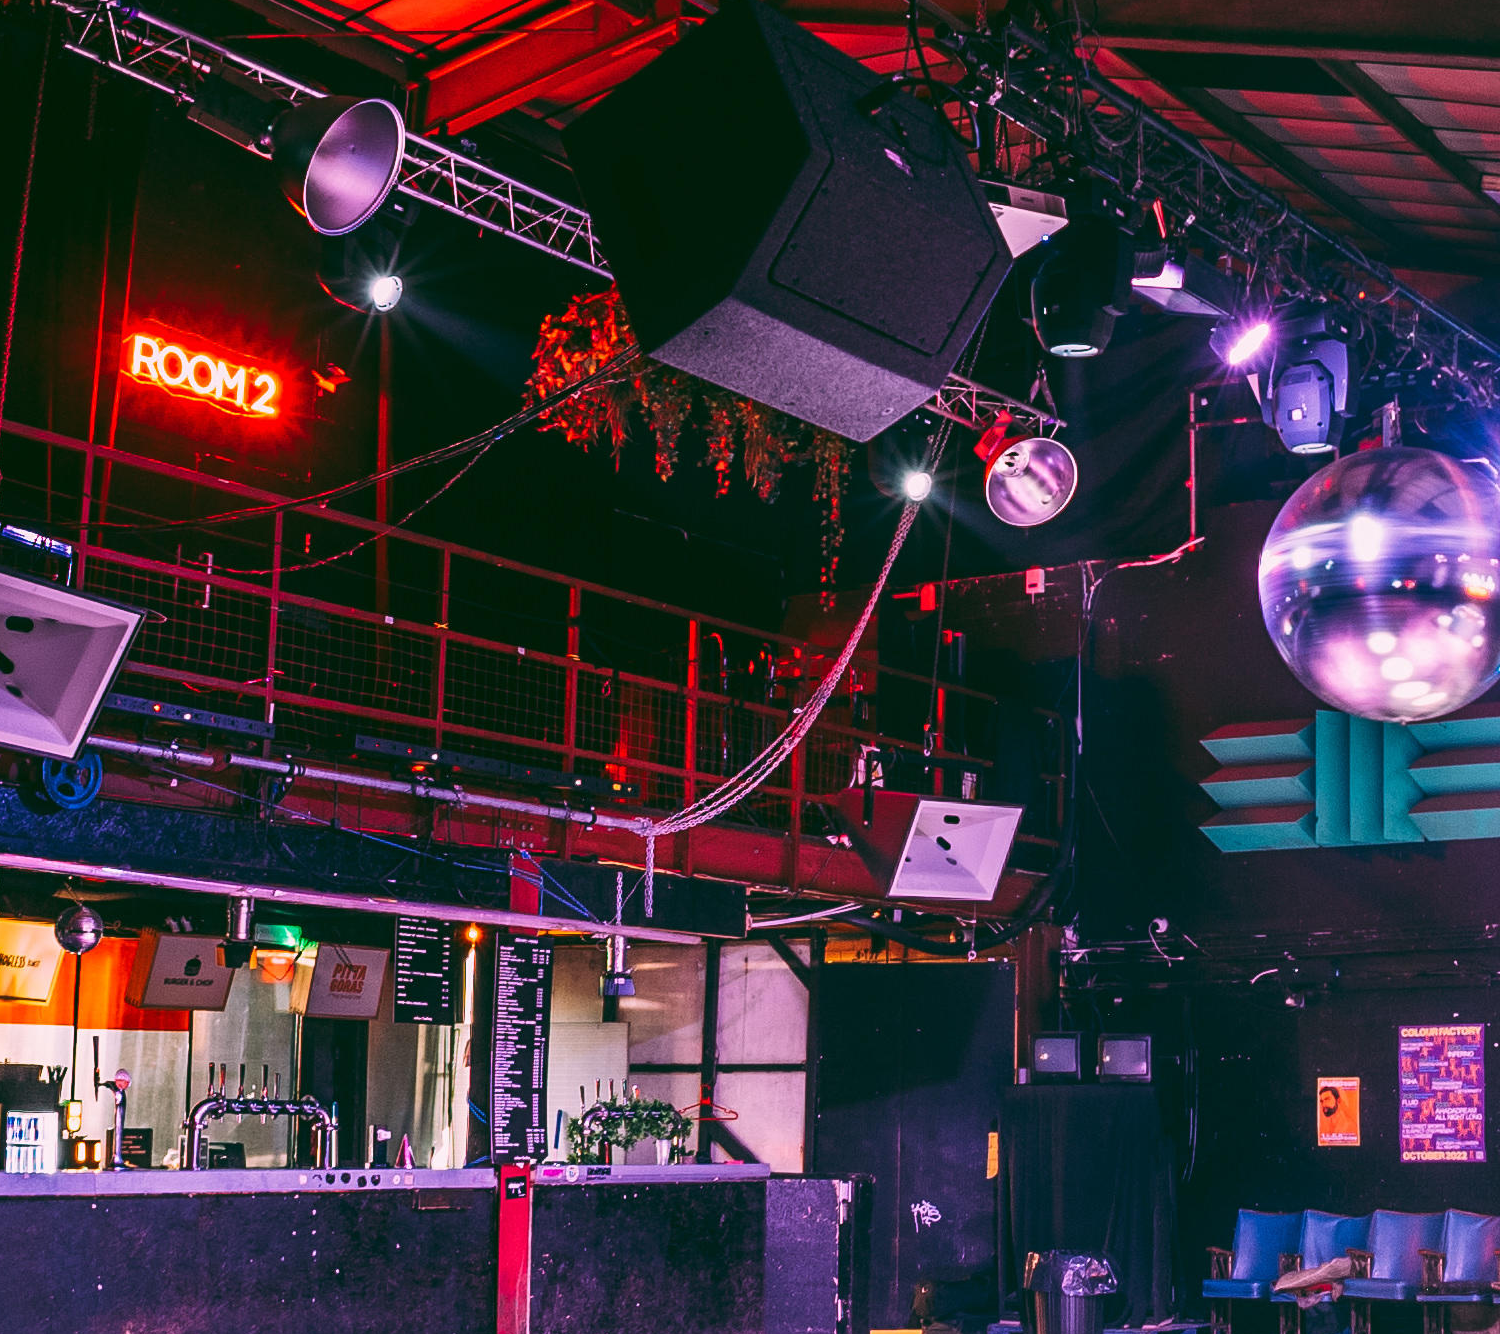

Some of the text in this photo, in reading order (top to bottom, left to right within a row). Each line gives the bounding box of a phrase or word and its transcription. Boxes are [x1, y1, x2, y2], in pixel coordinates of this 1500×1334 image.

[131, 333, 276, 415] ROOM 2
[330, 979, 364, 993] GORAS
[1401, 1027, 1481, 1037] COLOUR FACTORY
[1403, 1152, 1468, 1160] OCTOBER 2022
